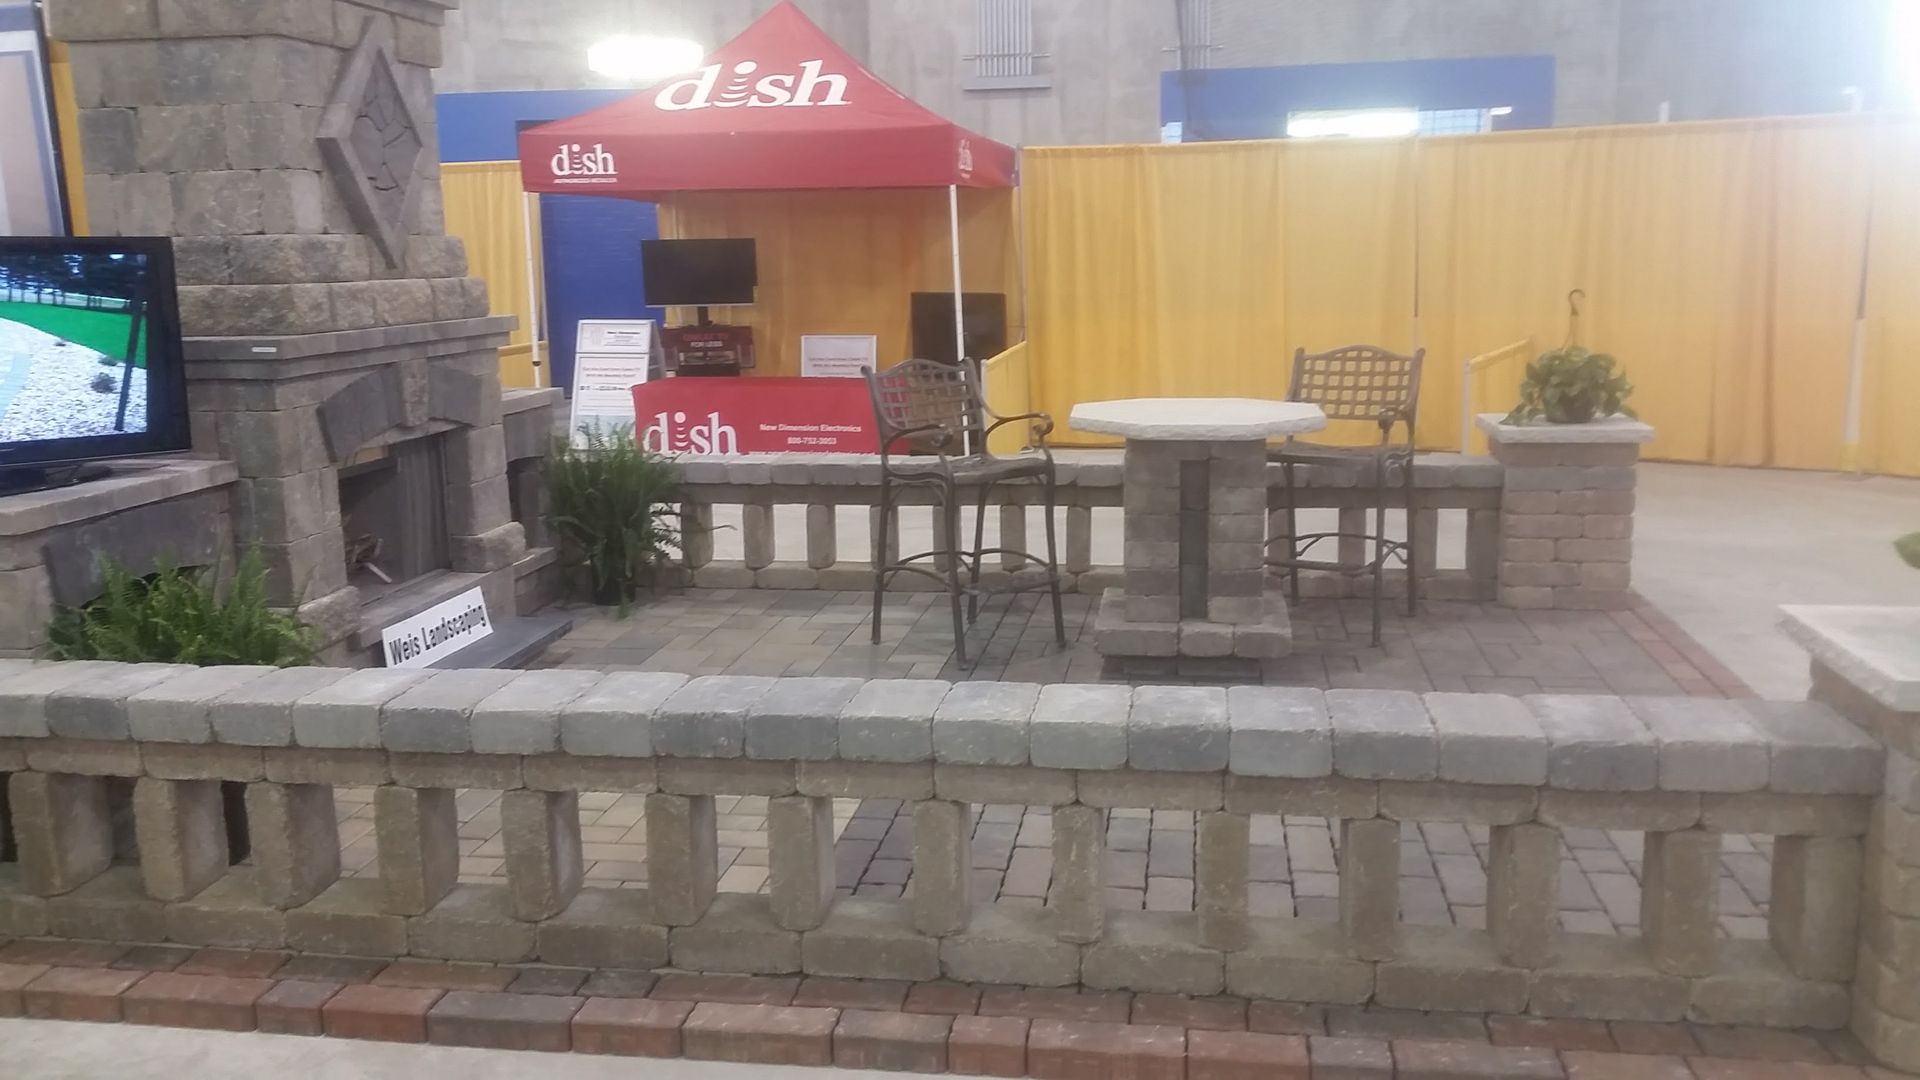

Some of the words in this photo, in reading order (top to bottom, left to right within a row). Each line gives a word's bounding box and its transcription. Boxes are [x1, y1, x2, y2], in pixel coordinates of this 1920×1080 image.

[654, 59, 853, 111] dish
[551, 143, 618, 176] dish
[642, 411, 741, 457] dish
[759, 423, 777, 432] New
[778, 423, 819, 432] Dimension
[820, 423, 861, 433] Electronics
[389, 633, 421, 665] Weis
[421, 604, 486, 651] Landscaping
